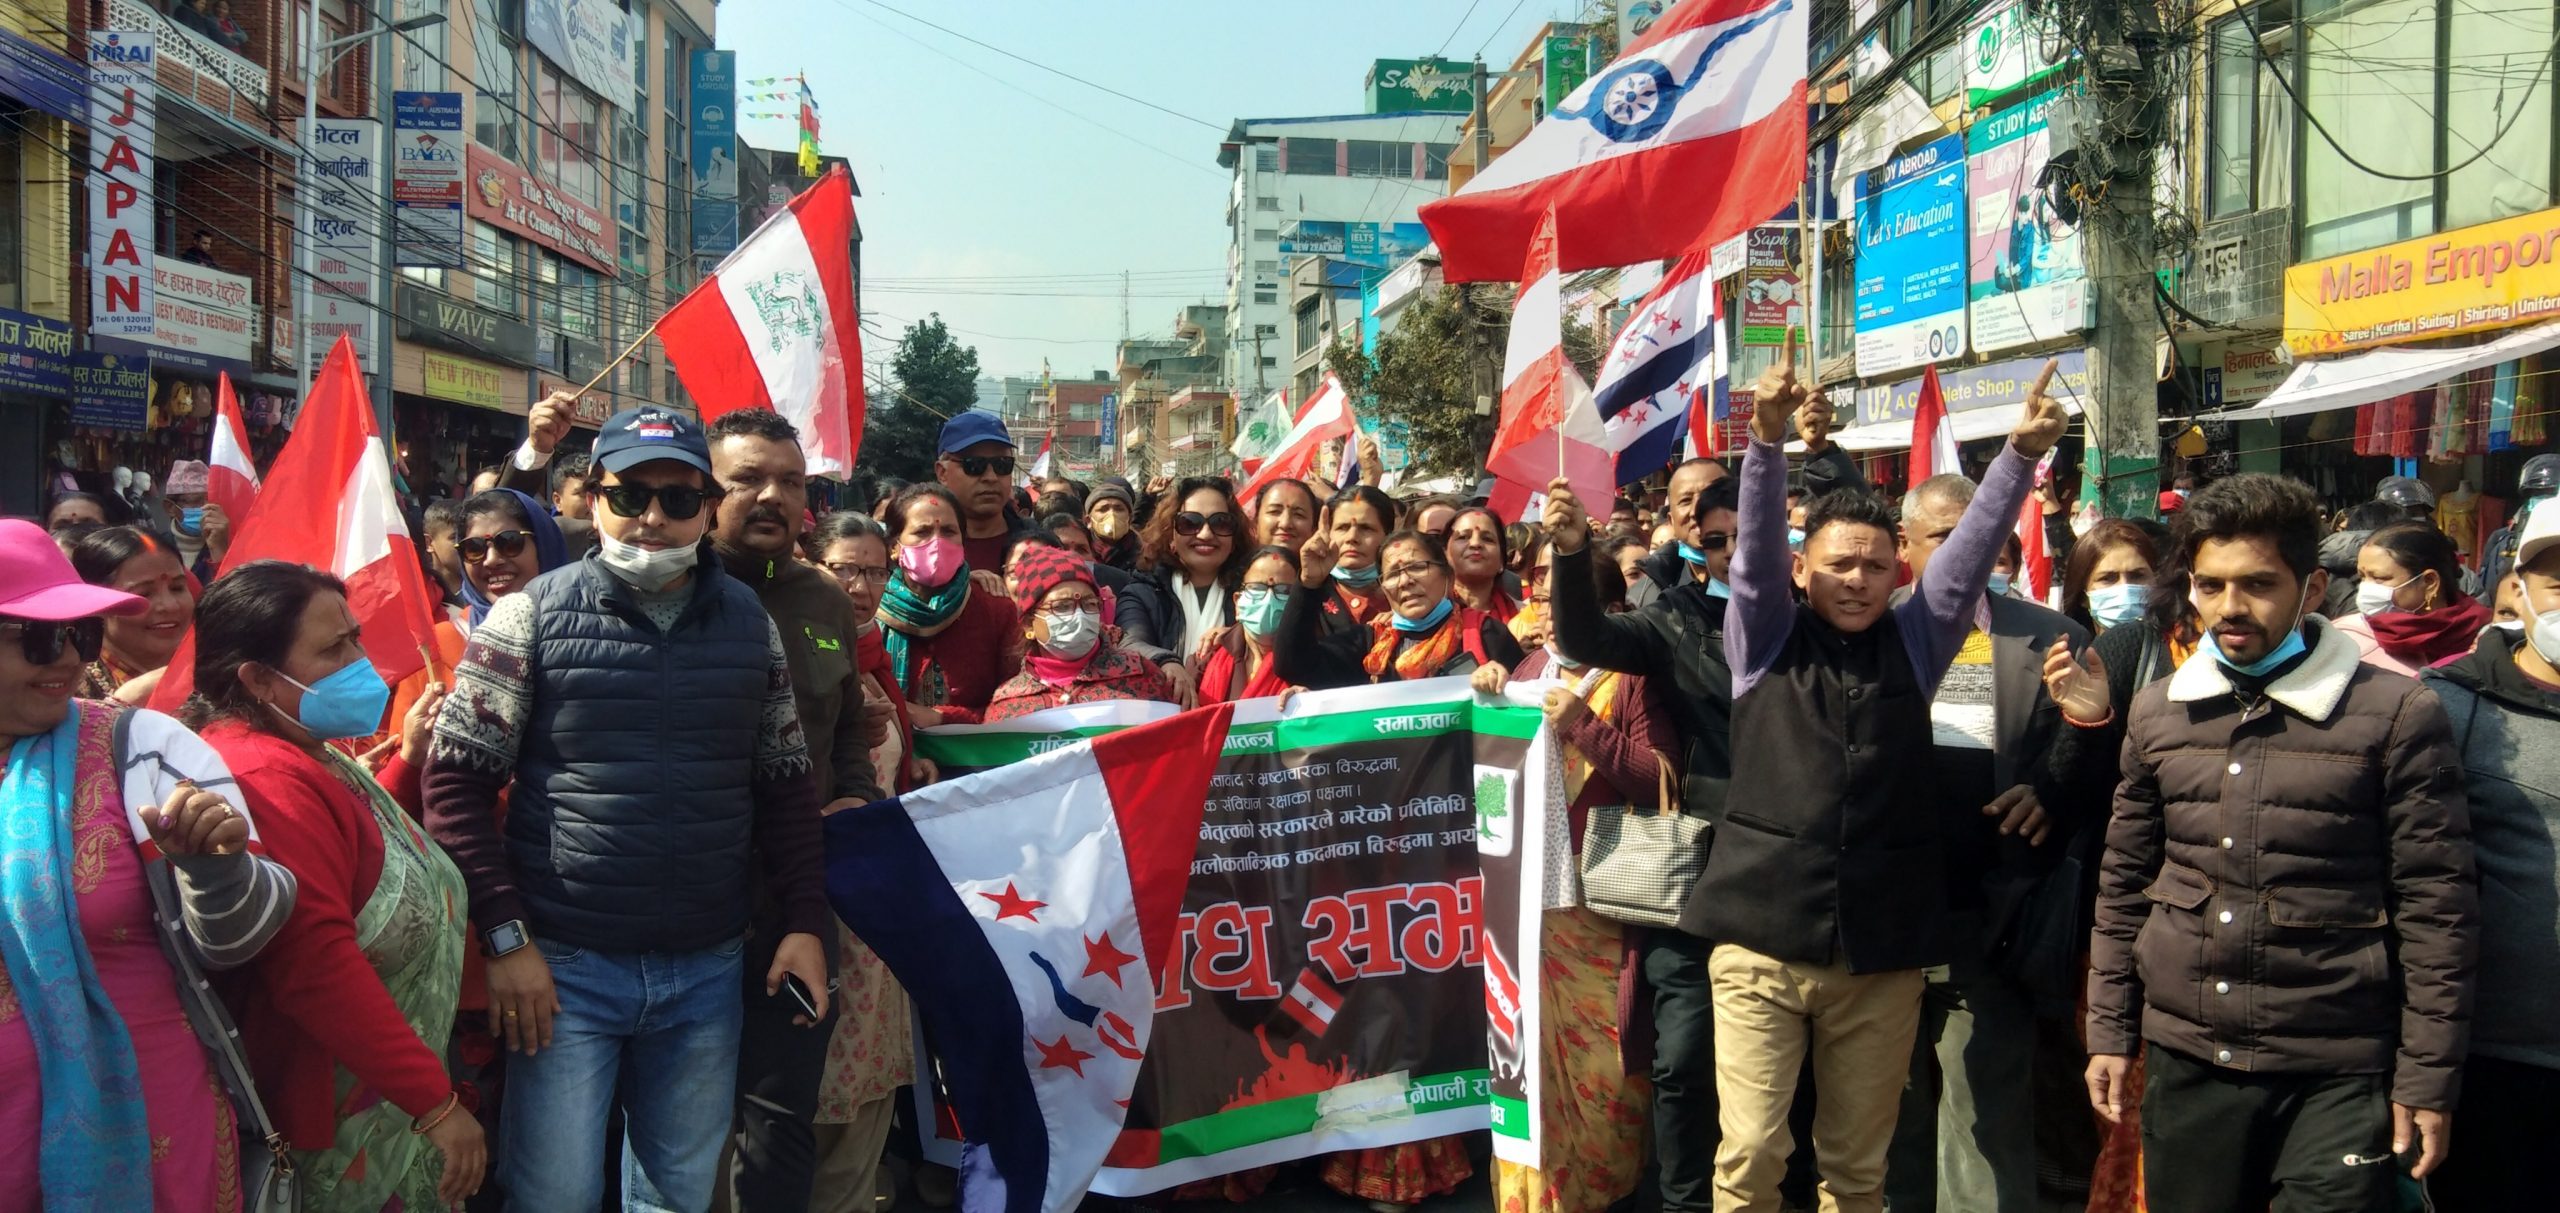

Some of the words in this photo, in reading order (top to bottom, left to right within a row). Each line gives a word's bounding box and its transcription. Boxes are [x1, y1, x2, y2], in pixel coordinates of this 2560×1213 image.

[93, 74, 132, 83] STUDY
[701, 74, 725, 82] STUDY
[1988, 110, 2026, 141] STUDY
[1868, 163, 1897, 189] STUDY
[1898, 147, 1937, 178] ABROAD
[102, 88, 138, 313] JAPAN
[520, 176, 542, 204] The
[576, 207, 601, 236] House
[1867, 218, 1892, 248] Let's
[1895, 200, 1954, 238] Education
[1292, 244, 1309, 252] NEW
[1310, 244, 1344, 252] ZEALAND
[1351, 233, 1374, 243] IELTS
[1749, 249, 1775, 257] Beauty
[1749, 257, 1785, 267] Parlour
[320, 260, 348, 274] HOTEL
[2320, 254, 2413, 305] Malla
[155, 301, 173, 321] UEST
[175, 305, 198, 327] HOUSE
[207, 312, 247, 335] RESTAURANT
[328, 302, 338, 317] &
[437, 303, 498, 342] WAVE
[2342, 328, 2370, 343] Saree
[2376, 319, 2411, 337] Kurtha
[2418, 312, 2456, 330] Suiting
[2465, 304, 2510, 322] Shirting
[2518, 295, 2560, 315] Unifor
[312, 321, 363, 338] ESTAURANT
[428, 358, 457, 384] NEW
[462, 367, 500, 394] PINCH
[82, 386, 98, 395] RAJ
[100, 387, 145, 399] JEWELLERS
[1867, 387, 1892, 422] U2
[1895, 398, 1906, 411] A
[1908, 384, 1972, 409] Cplete
[1976, 377, 2015, 399] Shop
[575, 396, 610, 423] OMPLEX
[1373, 711, 1463, 735] समाजवाद
[1247, 773, 1256, 787] र
[1221, 795, 1262, 813] संविधान
[1266, 791, 1313, 809] रक्षाका
[1258, 808, 1334, 839] सरकारले
[1340, 803, 1394, 826] गरेको
[1398, 794, 1467, 821] प्रतिनिधि
[1295, 840, 1361, 865] कदमका
[1410, 1075, 1467, 1105] नेपाली
